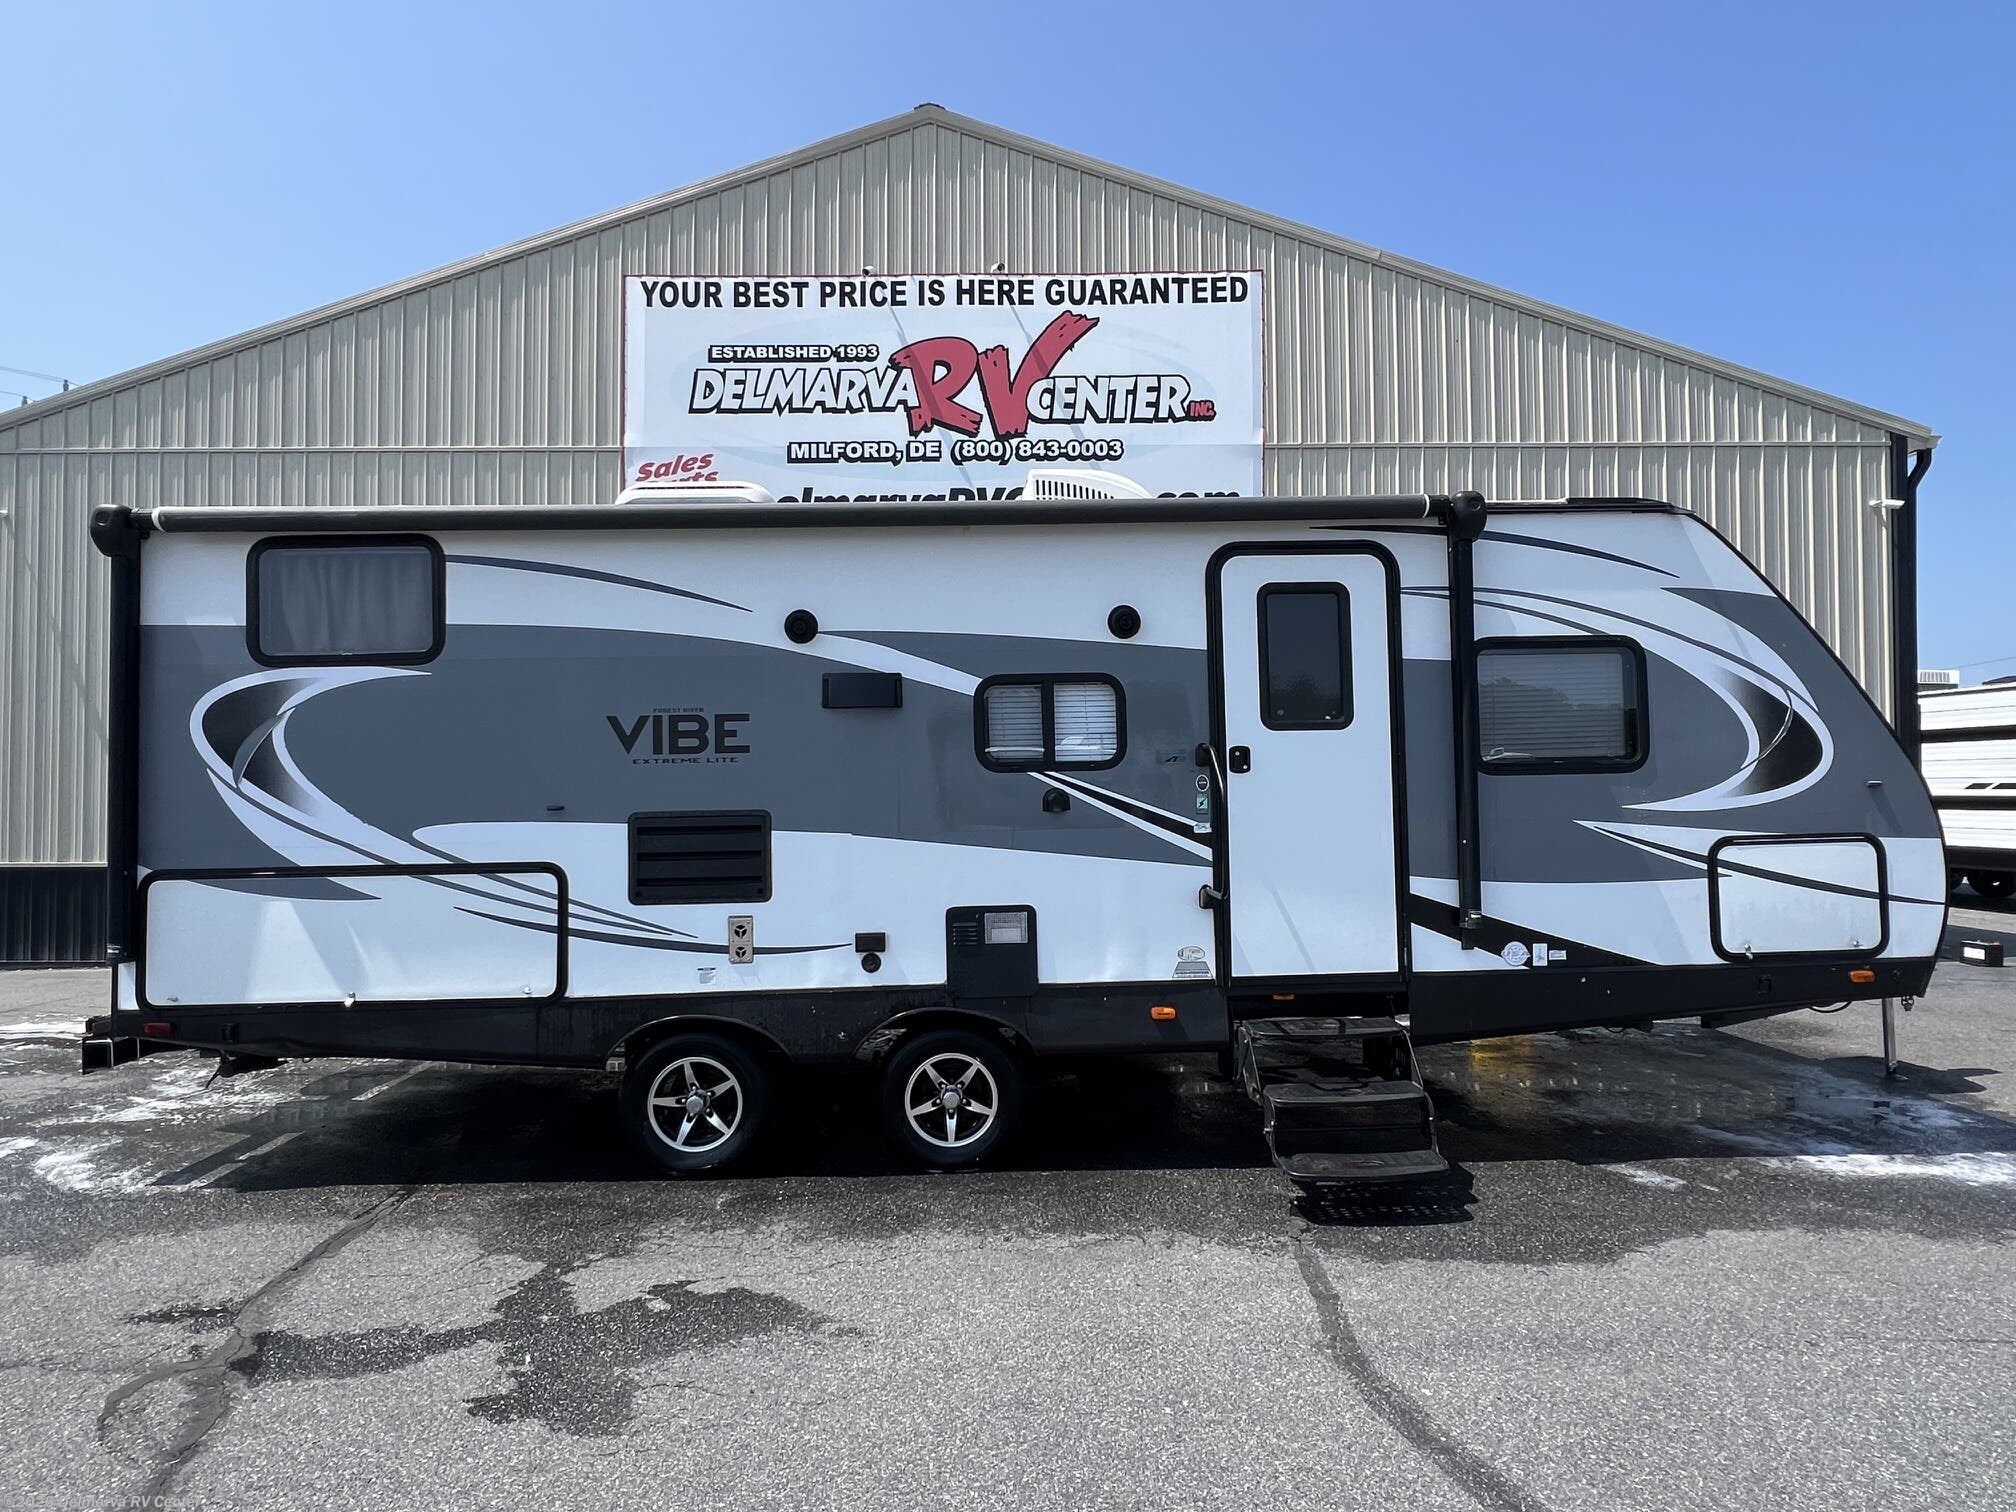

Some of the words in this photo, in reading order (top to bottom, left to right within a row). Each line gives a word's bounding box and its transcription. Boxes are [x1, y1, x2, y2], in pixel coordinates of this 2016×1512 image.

[640, 281, 723, 308] YOUR
[733, 281, 809, 308] BEST
[819, 280, 907, 307] PRICE
[917, 280, 945, 306] IS
[956, 279, 1034, 306] HERE
[1045, 277, 1248, 305] GUARANTEED
[709, 346, 832, 362] ESTABLISHED
[837, 345, 879, 360] 1993
[689, 368, 921, 415] DELMARVA
[889, 310, 1100, 438] RV
[1025, 375, 1190, 423] CENTER
[788, 441, 904, 465] MILFORD,
[907, 441, 942, 462] DE
[952, 440, 1013, 464] (800)
[1017, 439, 1124, 461] 843-0003
[606, 713, 750, 755] VIBE
[632, 757, 702, 765] EXTREME
[706, 756, 739, 764] LITE
